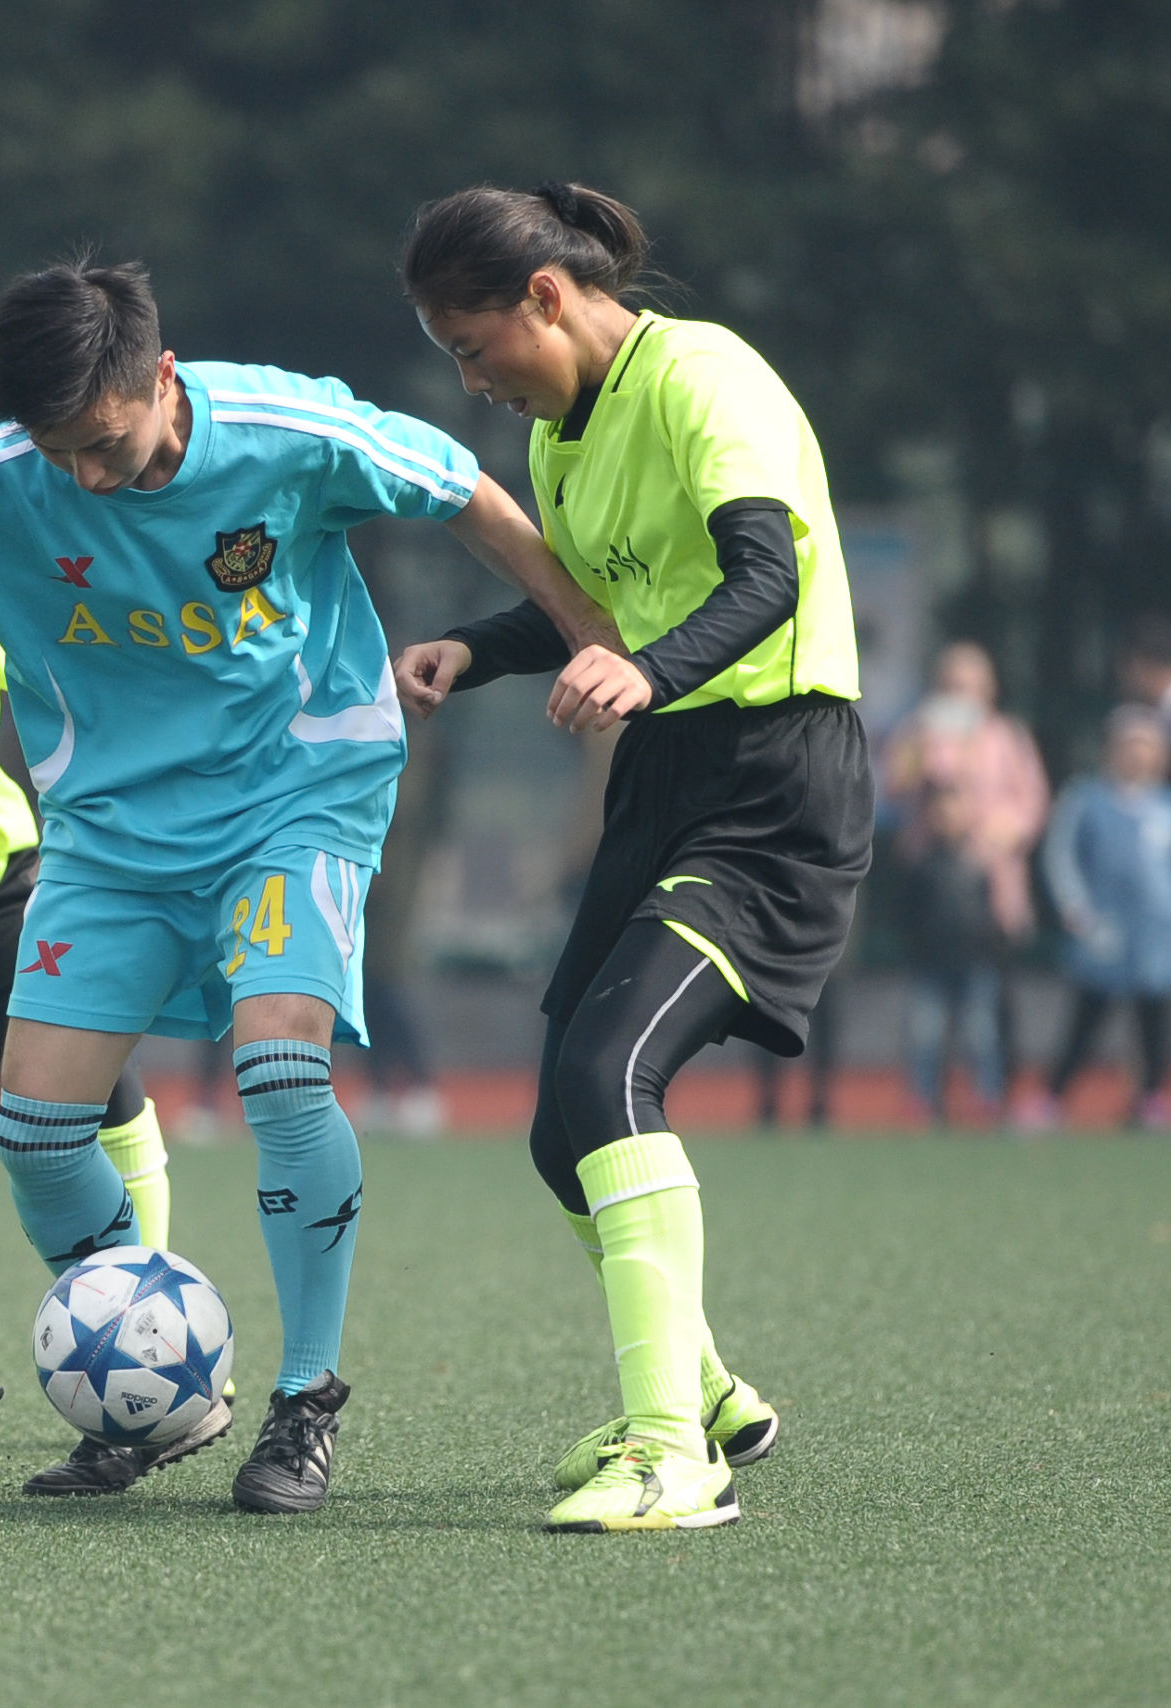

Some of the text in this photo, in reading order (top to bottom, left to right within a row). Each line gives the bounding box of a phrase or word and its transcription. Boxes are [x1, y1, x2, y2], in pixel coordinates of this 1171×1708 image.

[57, 586, 287, 656] ASSA
[225, 872, 293, 979] 24
[120, 1391, 158, 1405] adidas
